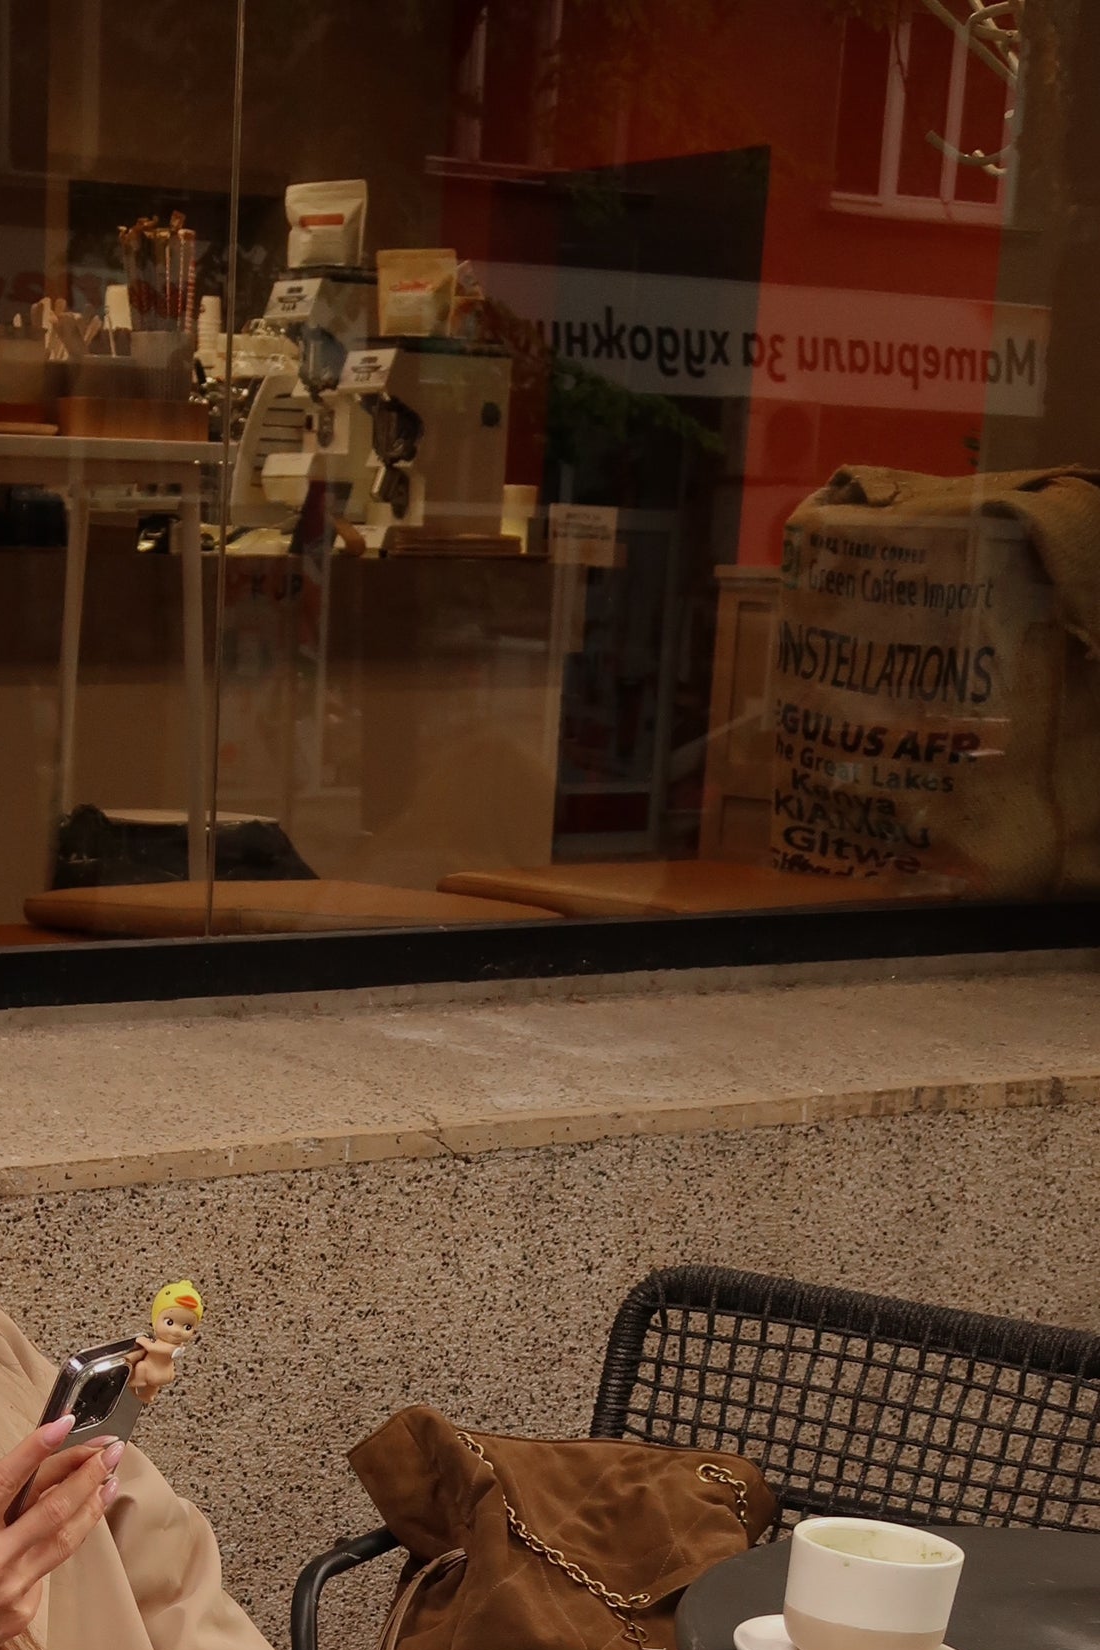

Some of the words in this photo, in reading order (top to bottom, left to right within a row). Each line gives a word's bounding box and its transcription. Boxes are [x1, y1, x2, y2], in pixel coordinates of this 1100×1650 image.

[807, 558, 855, 599] Green
[861, 569, 918, 607] Coffee
[923, 576, 995, 618] Import
[777, 620, 996, 704] NSTELLATIONS
[777, 699, 889, 758] GULUS
[776, 733, 795, 761] he
[799, 747, 861, 784] Great
[871, 766, 955, 793] Lakes
